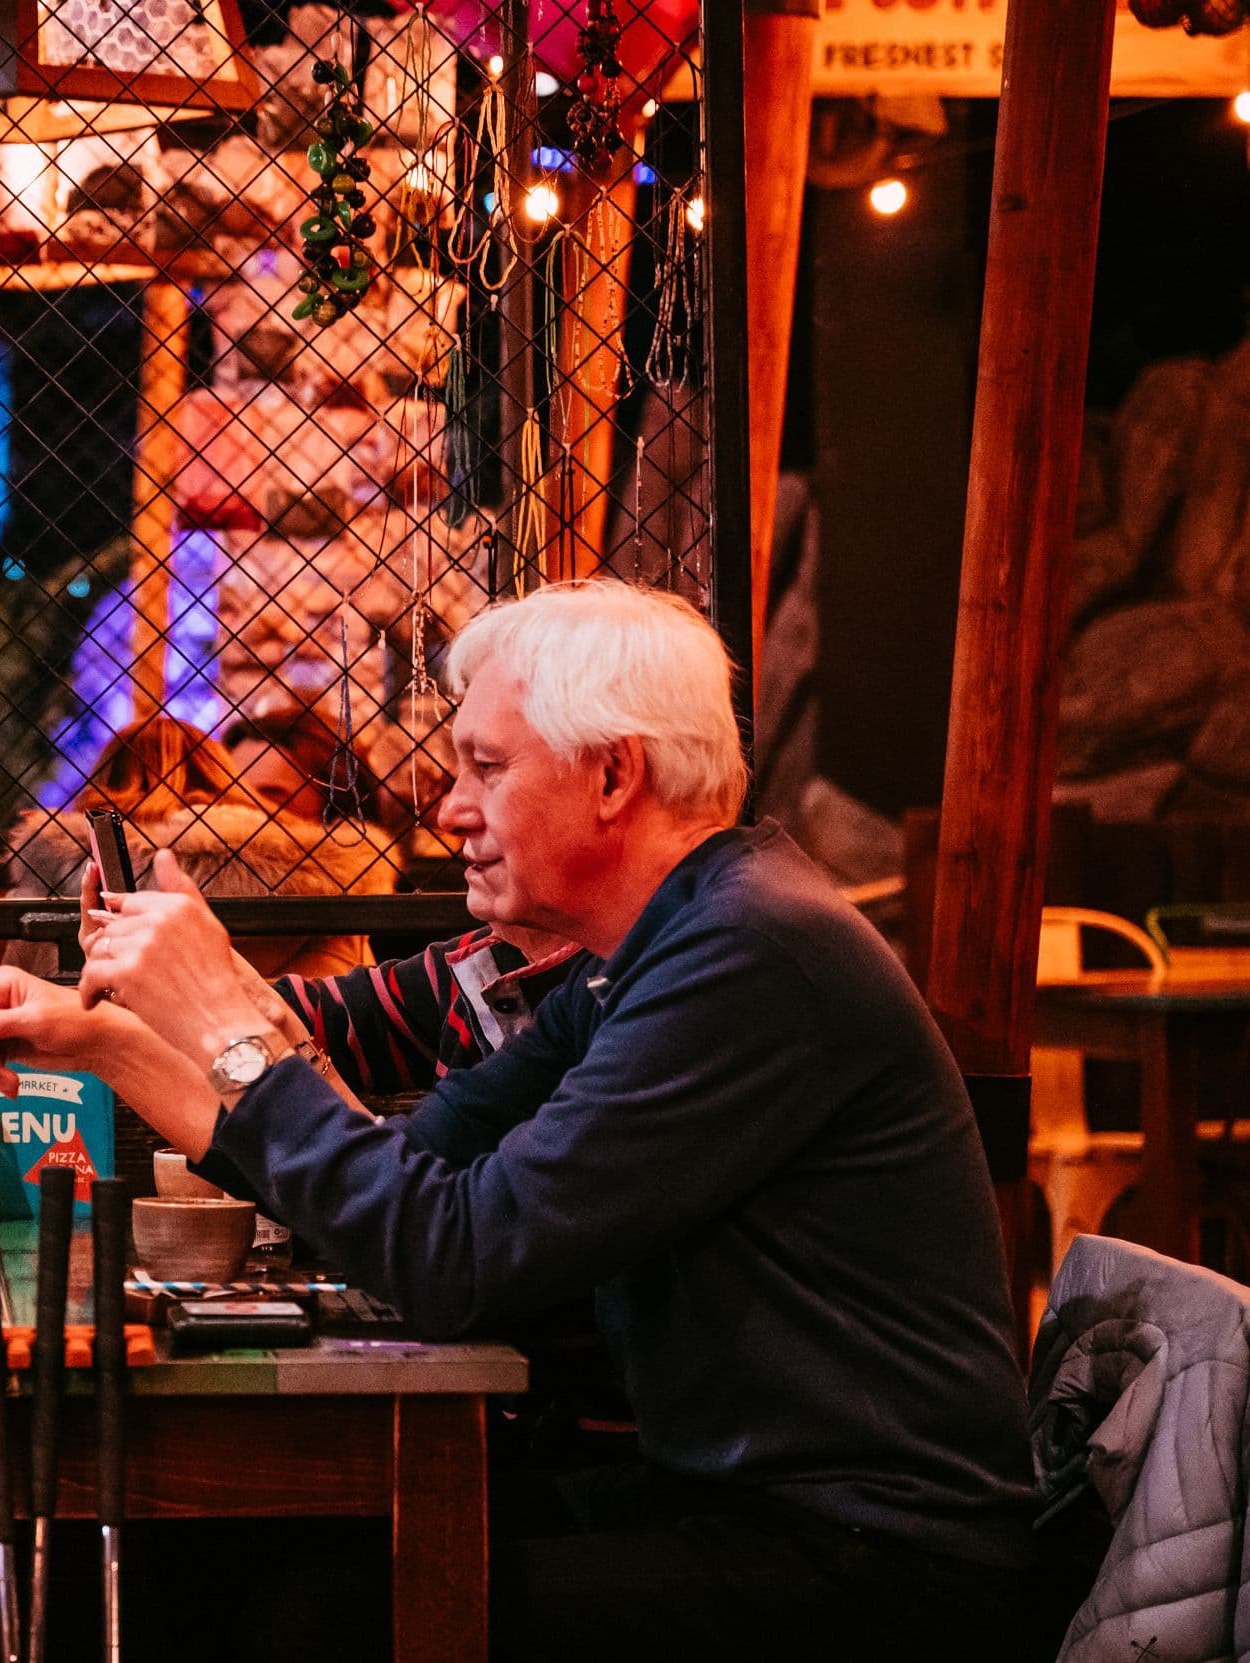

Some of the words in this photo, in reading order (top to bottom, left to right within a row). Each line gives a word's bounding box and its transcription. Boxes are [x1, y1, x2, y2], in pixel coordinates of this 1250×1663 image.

[824, 43, 971, 69] FRESHEST
[989, 43, 1003, 68] S
[48, 1151, 87, 1164] PIZZA
